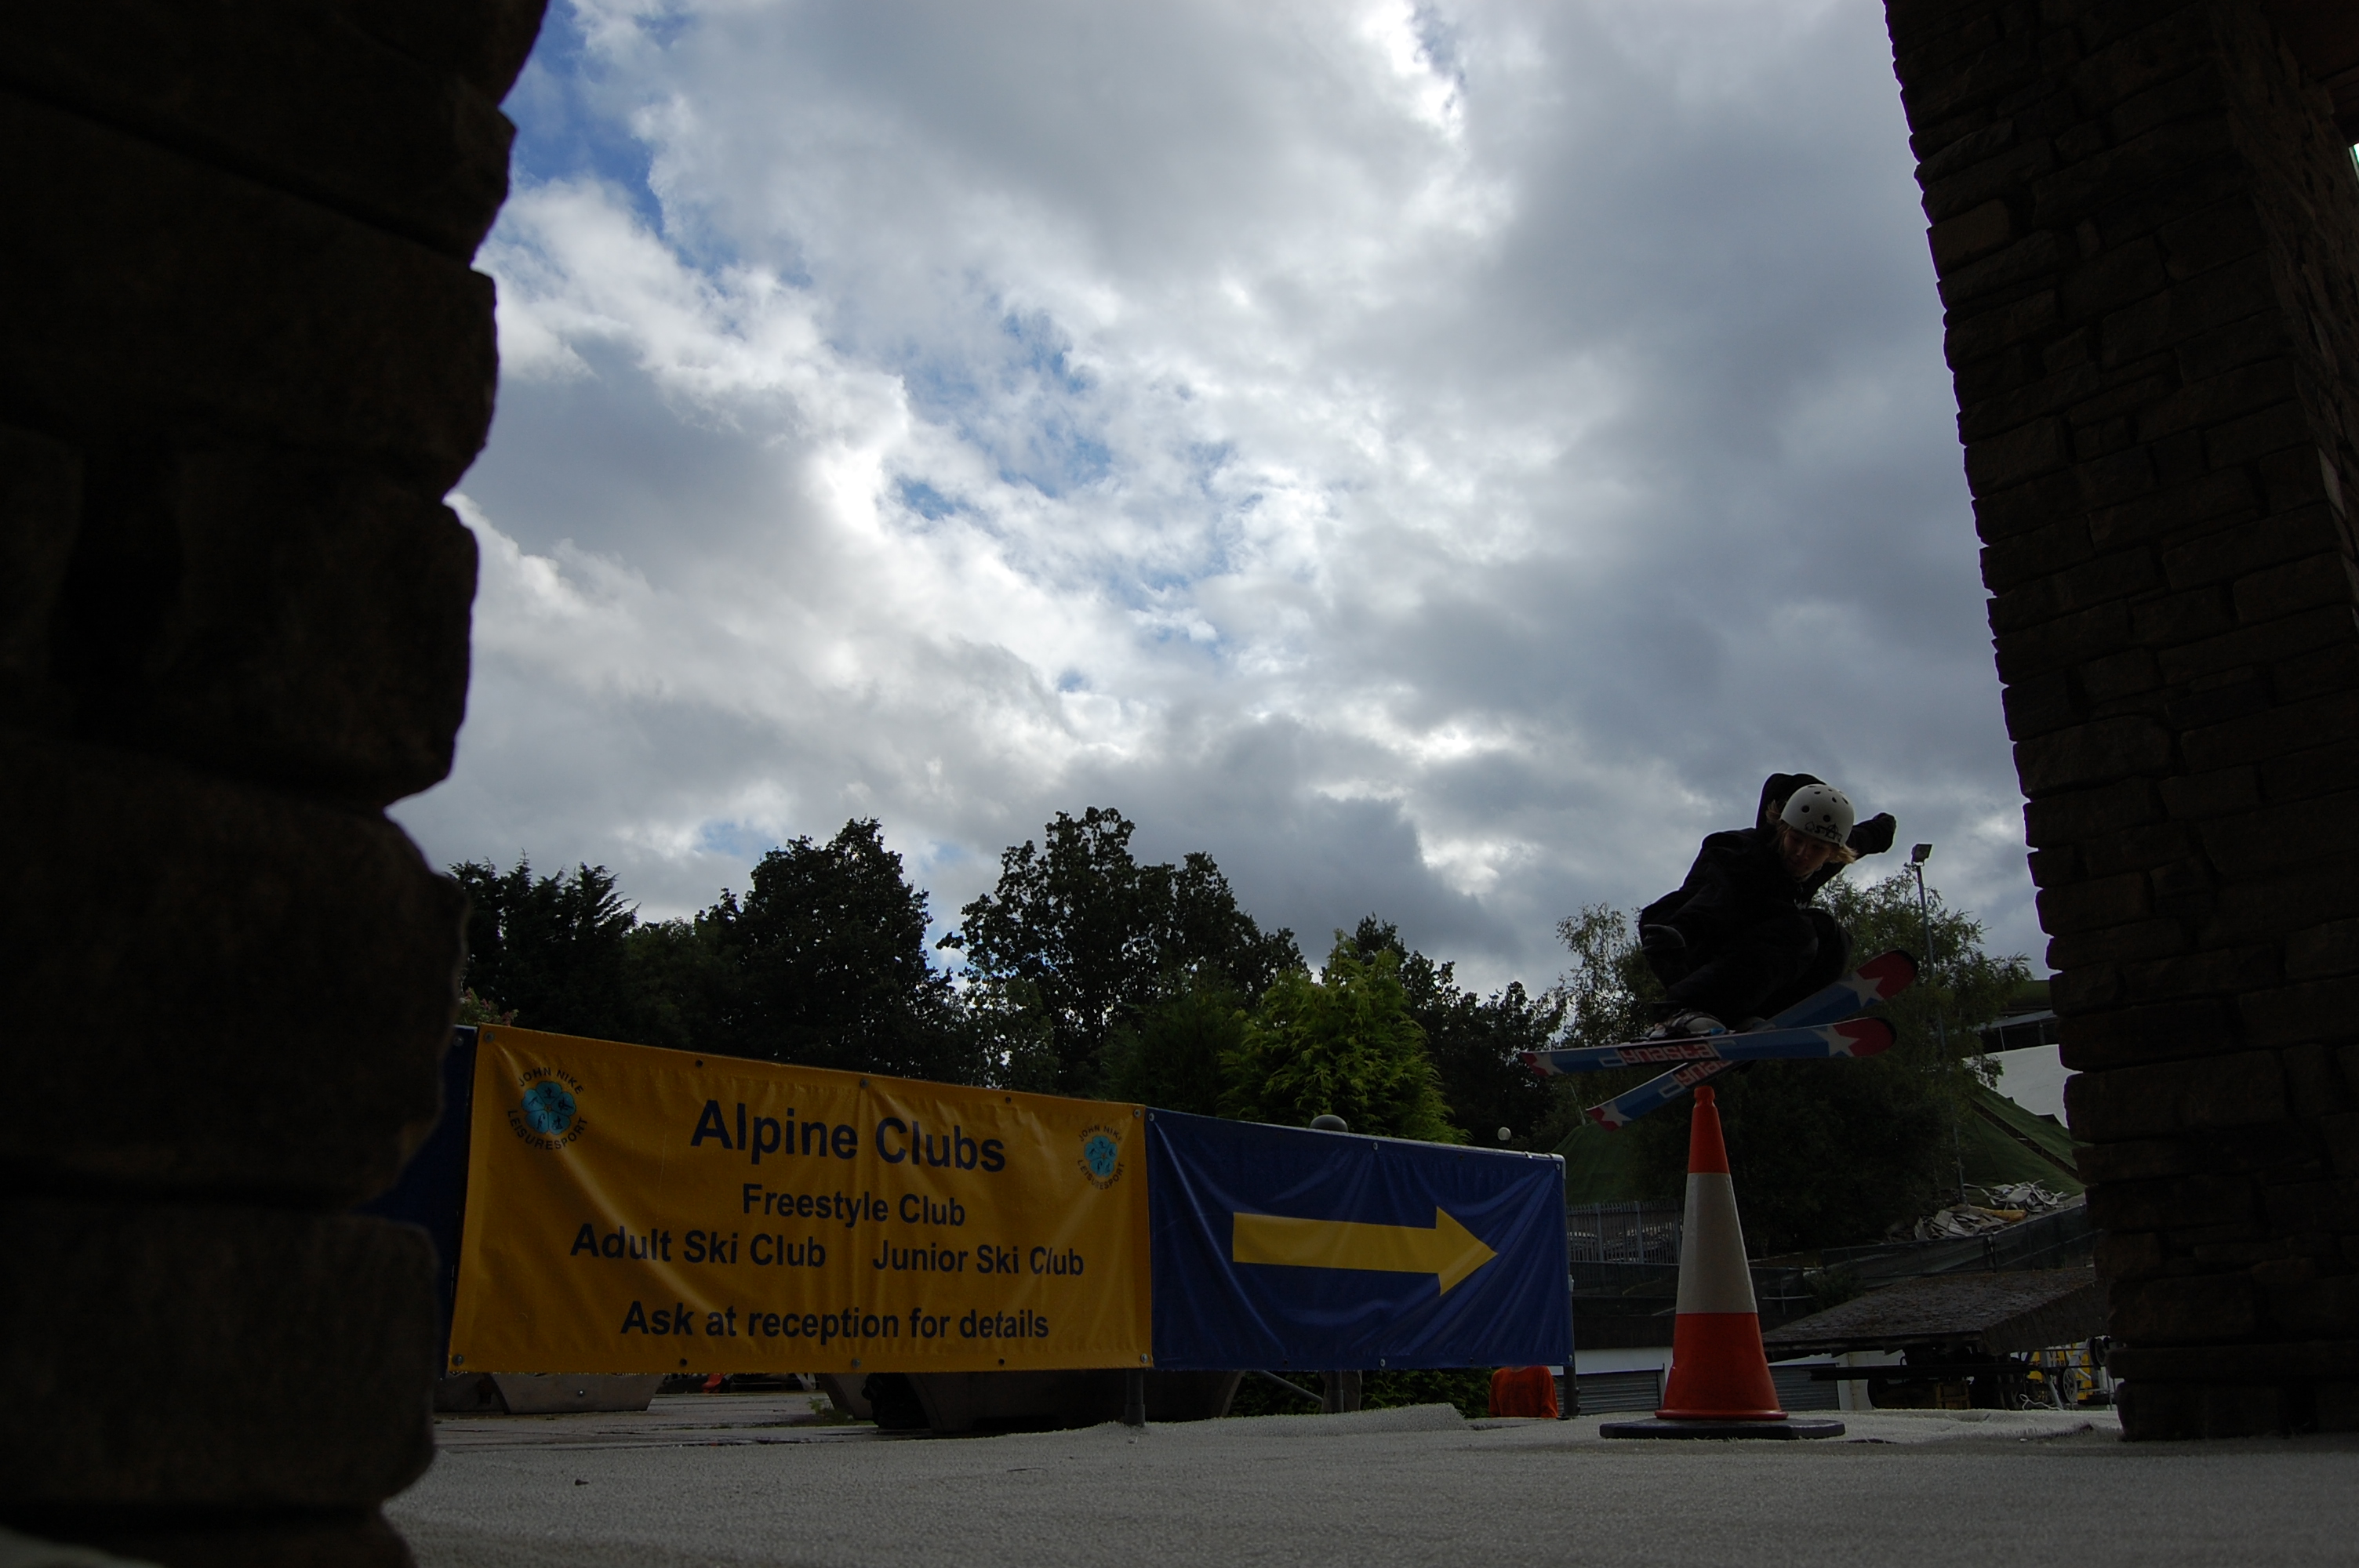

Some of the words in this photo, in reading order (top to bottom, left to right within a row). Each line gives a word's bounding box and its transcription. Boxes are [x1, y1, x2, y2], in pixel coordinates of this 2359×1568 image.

[518, 1067, 551, 1087] JOHN
[556, 1069, 584, 1094] NIKE
[507, 1109, 588, 1151] LEISURESPORT
[691, 1099, 858, 1165] Alpine
[876, 1116, 1005, 1173] Clubs
[1078, 1124, 1100, 1142] JOHN
[1077, 1160, 1125, 1190] LEISUESPORT
[743, 1183, 889, 1228] Freestyle
[899, 1193, 966, 1226] Club
[570, 1223, 672, 1261] Adult
[683, 1230, 738, 1264] Ski
[749, 1234, 826, 1268] Club
[872, 1240, 969, 1272] Junior
[976, 1243, 1020, 1274] Ski
[1030, 1247, 1084, 1276] Club
[620, 1301, 695, 1335] Ask
[705, 1306, 737, 1337] at
[747, 1307, 900, 1345] reception
[910, 1308, 950, 1338] for
[959, 1309, 1049, 1339] details
